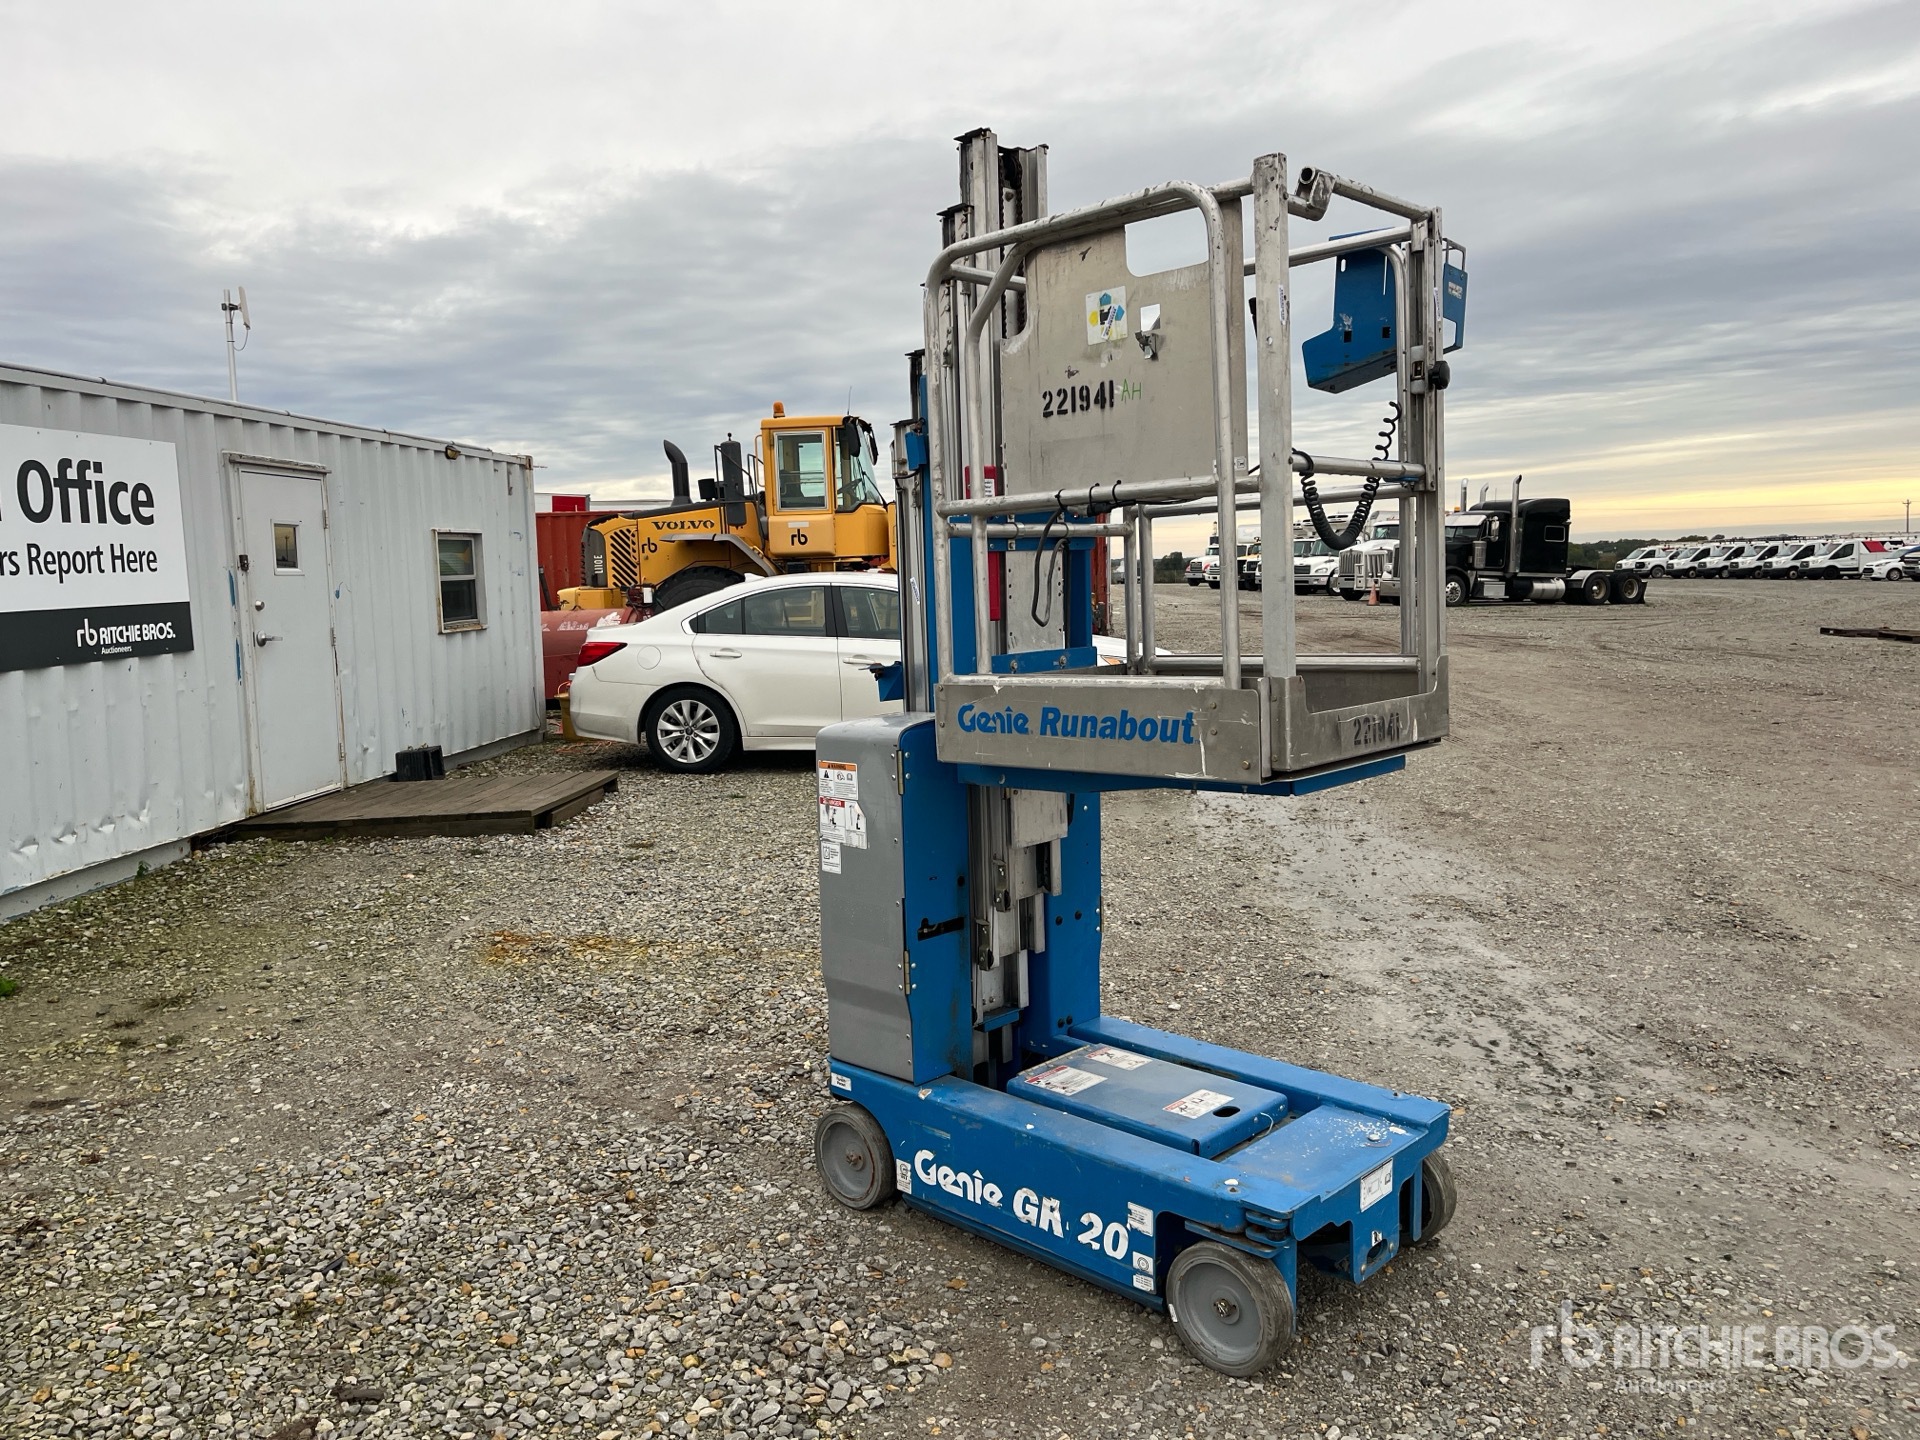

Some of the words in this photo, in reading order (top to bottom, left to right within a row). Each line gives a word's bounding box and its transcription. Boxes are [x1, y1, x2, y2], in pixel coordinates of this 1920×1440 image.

[1042, 379, 1115, 418] 221941
[1121, 379, 1142, 403] AH
[17, 458, 155, 525] Office
[651, 519, 715, 531] VOLVO
[26, 542, 106, 584] Report
[109, 543, 158, 573] Here
[99, 625, 141, 645] RITCHIE
[142, 621, 176, 640] BROS.
[101, 645, 132, 655] Auctioneers
[957, 703, 1029, 735] Genie
[1039, 706, 1195, 745] Runabout
[914, 1149, 1004, 1207] Genie
[1077, 1212, 1129, 1260] 20
